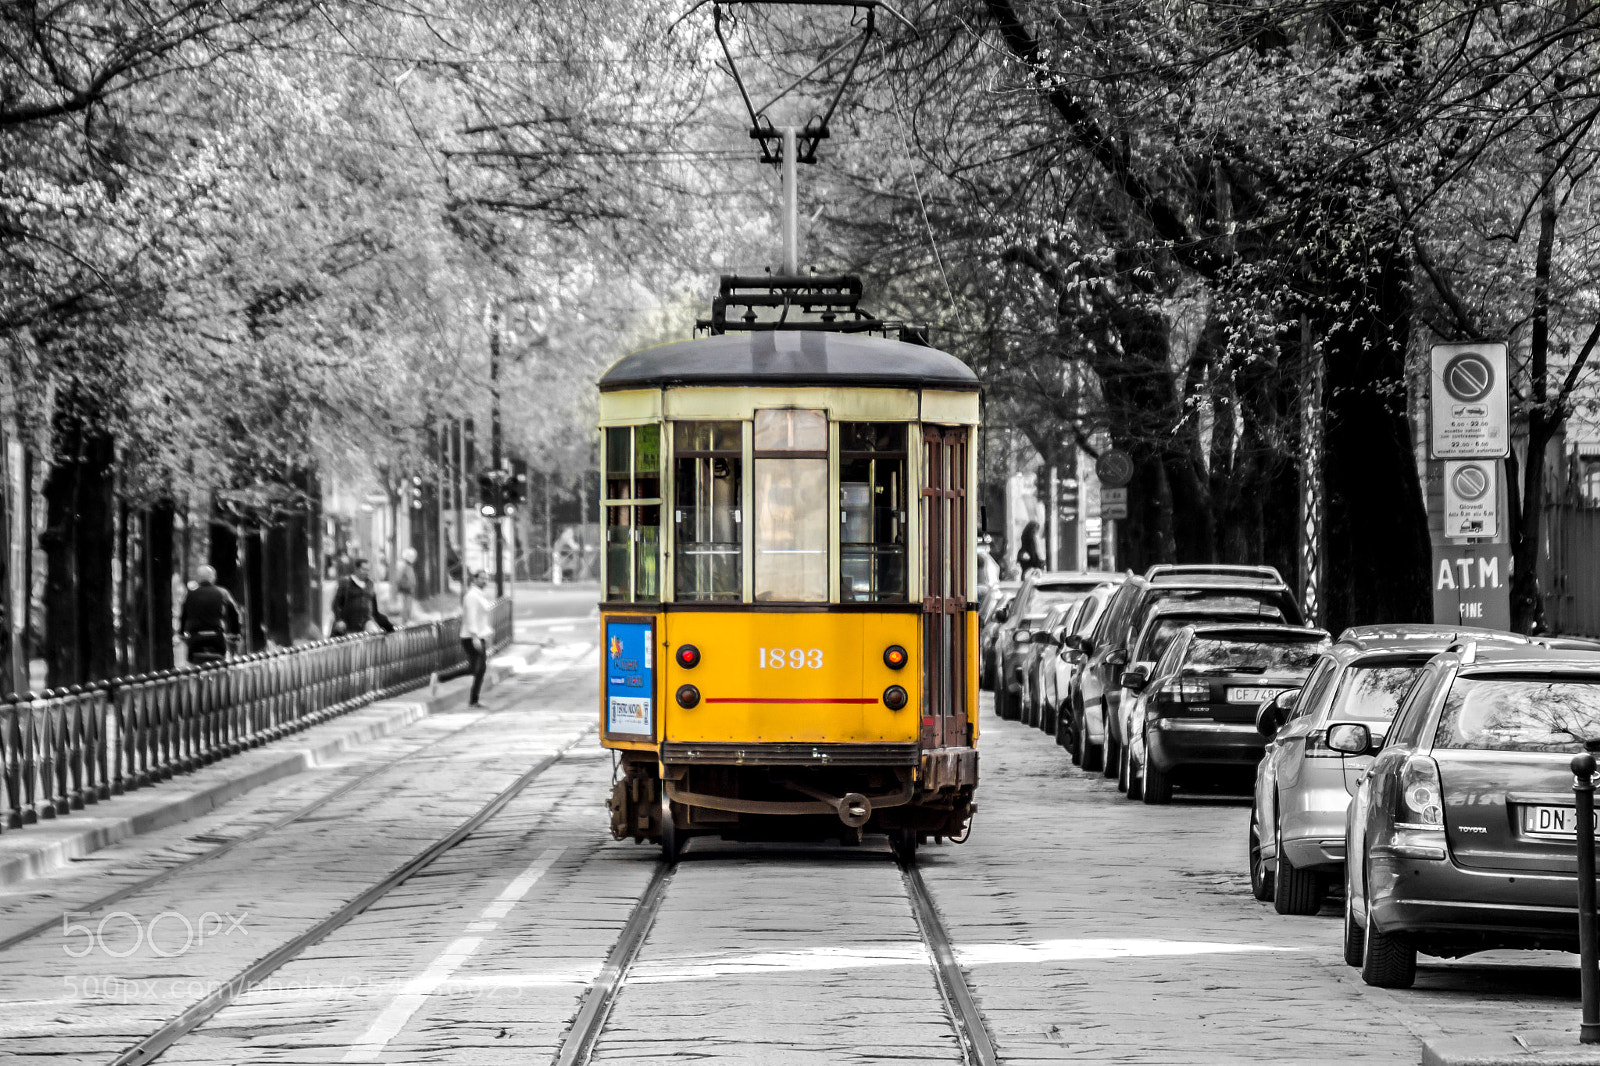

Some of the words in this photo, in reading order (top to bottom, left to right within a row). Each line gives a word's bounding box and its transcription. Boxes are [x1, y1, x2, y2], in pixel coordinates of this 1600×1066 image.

[1437, 556, 1503, 590] A.T.M.
[1460, 602, 1483, 618] FINE
[759, 647, 824, 669] 1893
[1236, 689, 1250, 701] CF
[1540, 809, 1565, 830] DN
[1458, 826, 1487, 834] TOYOTA
